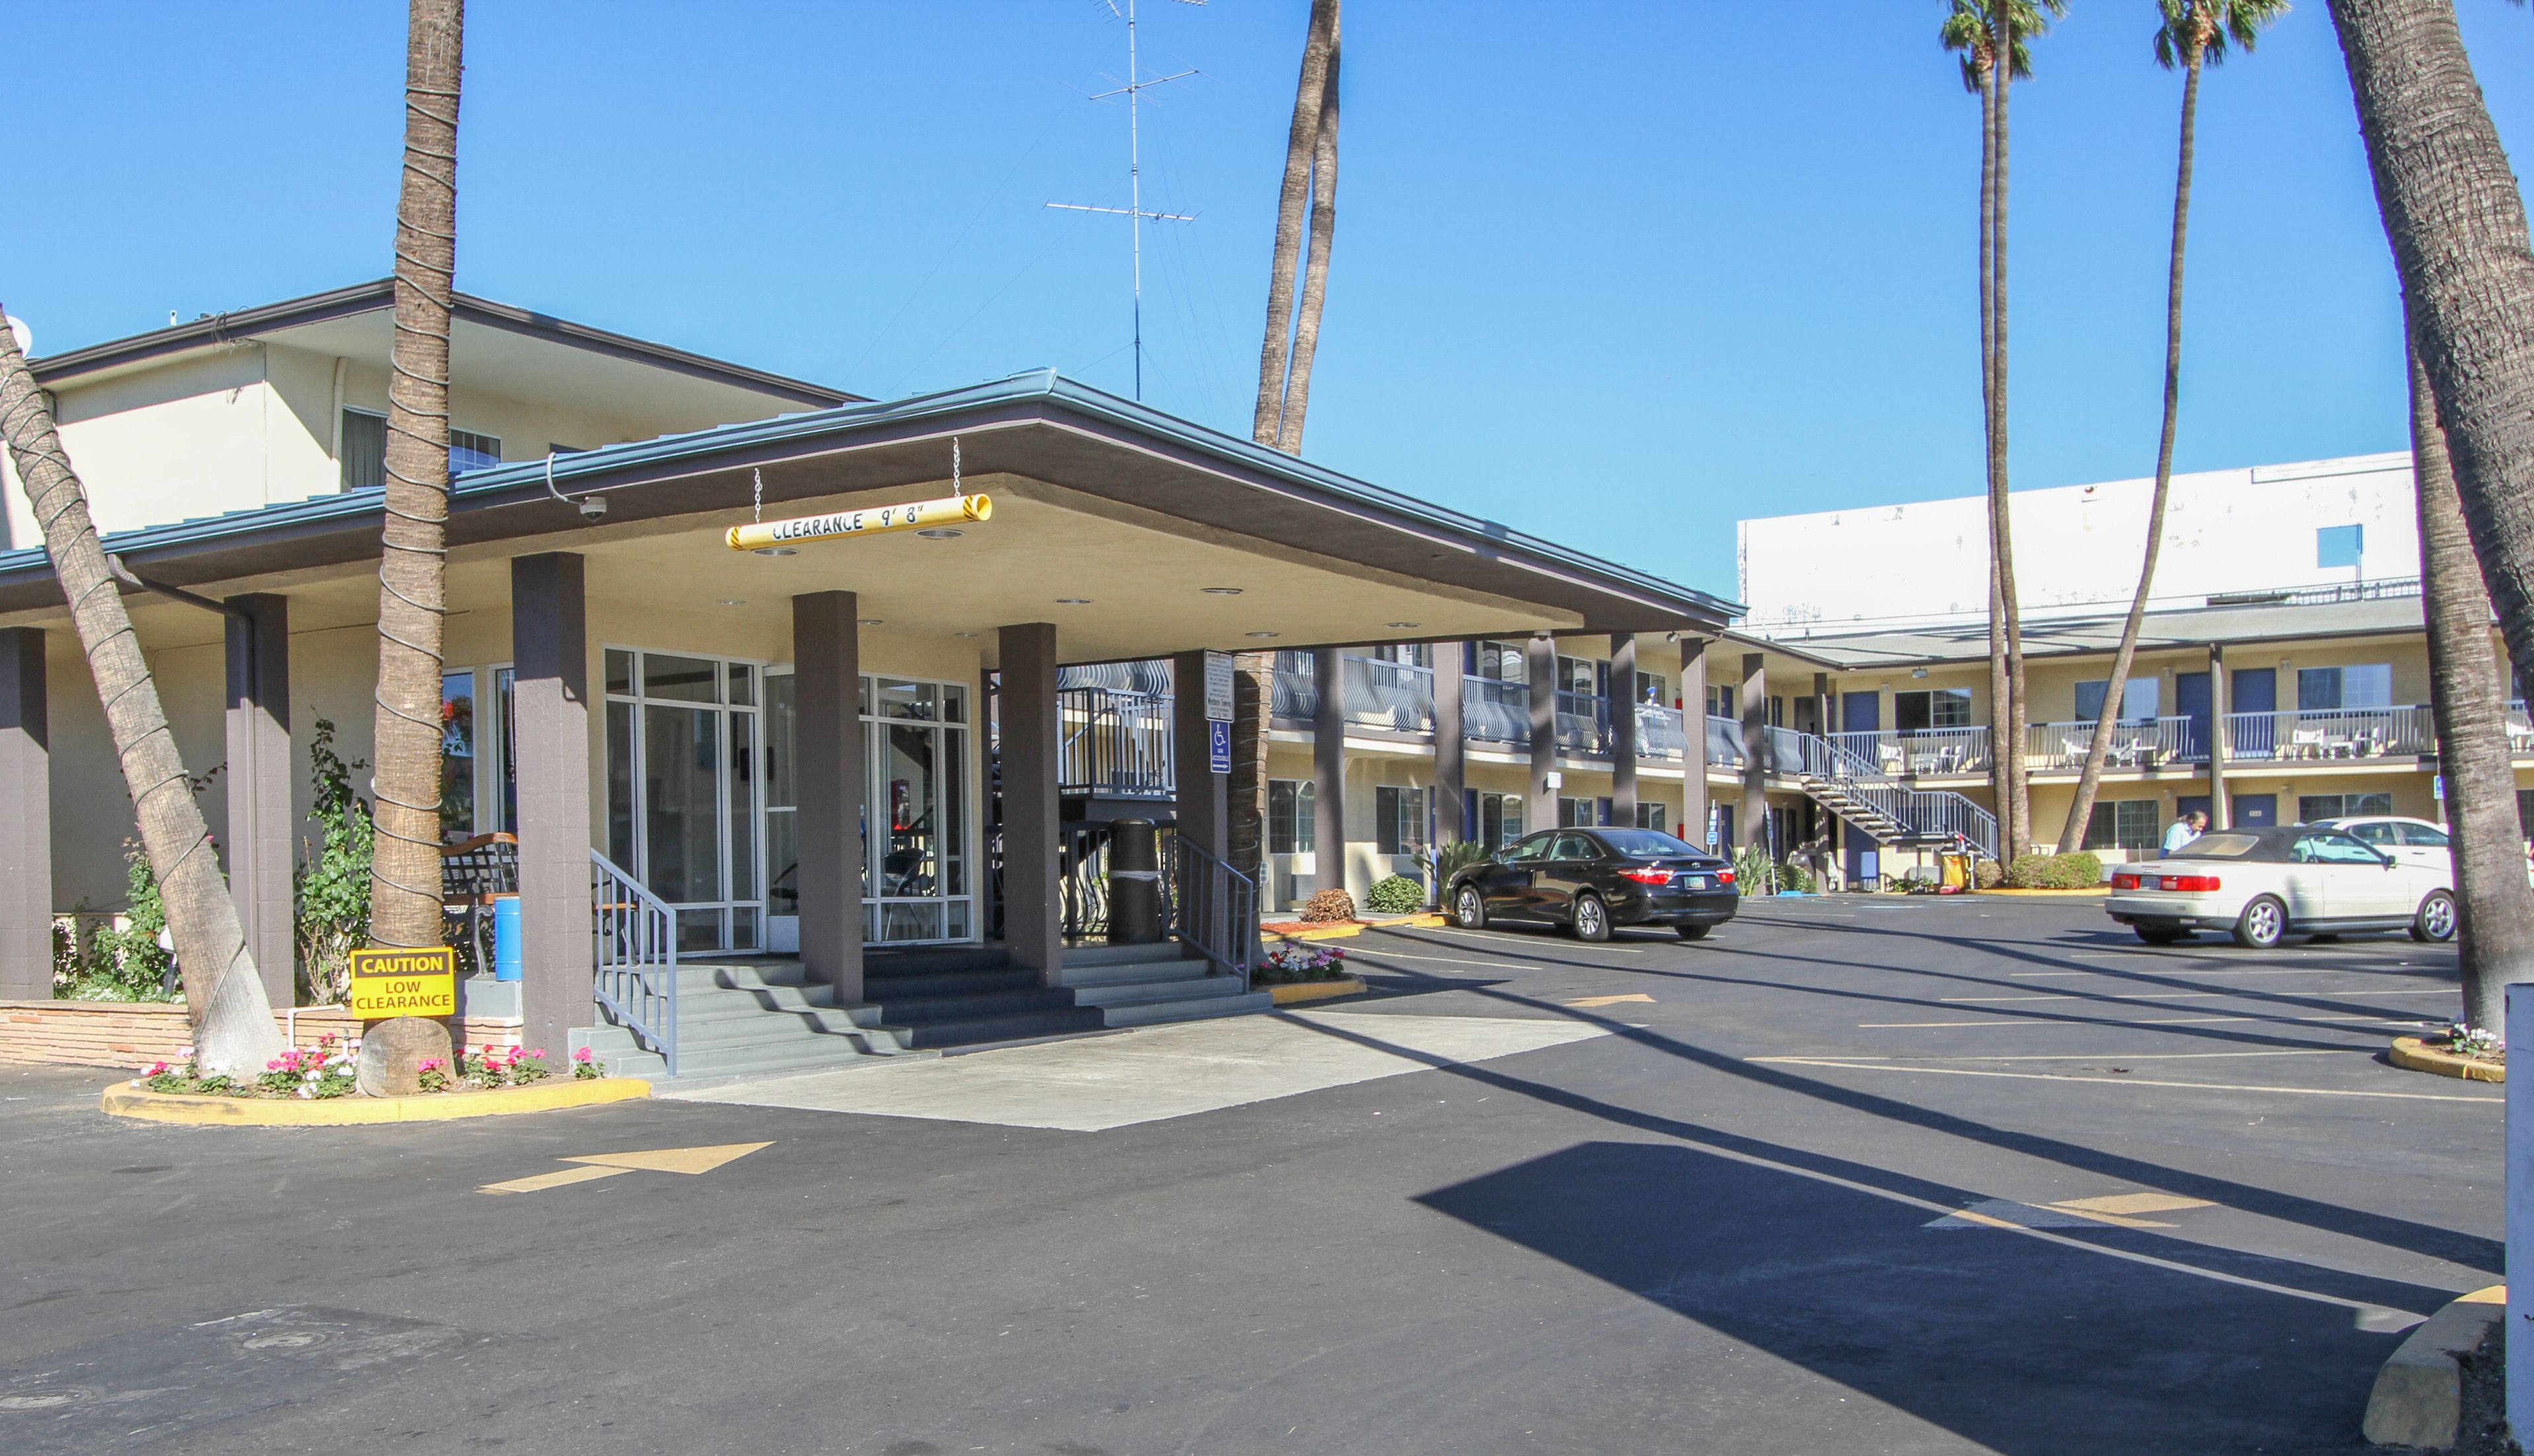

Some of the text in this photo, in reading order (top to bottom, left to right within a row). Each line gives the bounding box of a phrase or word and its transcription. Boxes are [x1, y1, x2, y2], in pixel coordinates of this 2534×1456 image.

[773, 505, 924, 540] CLEARANCE 9' 8"
[361, 956, 443, 973] CAUTION
[385, 981, 421, 994] LOW
[356, 994, 451, 1009] CLEARANCE
